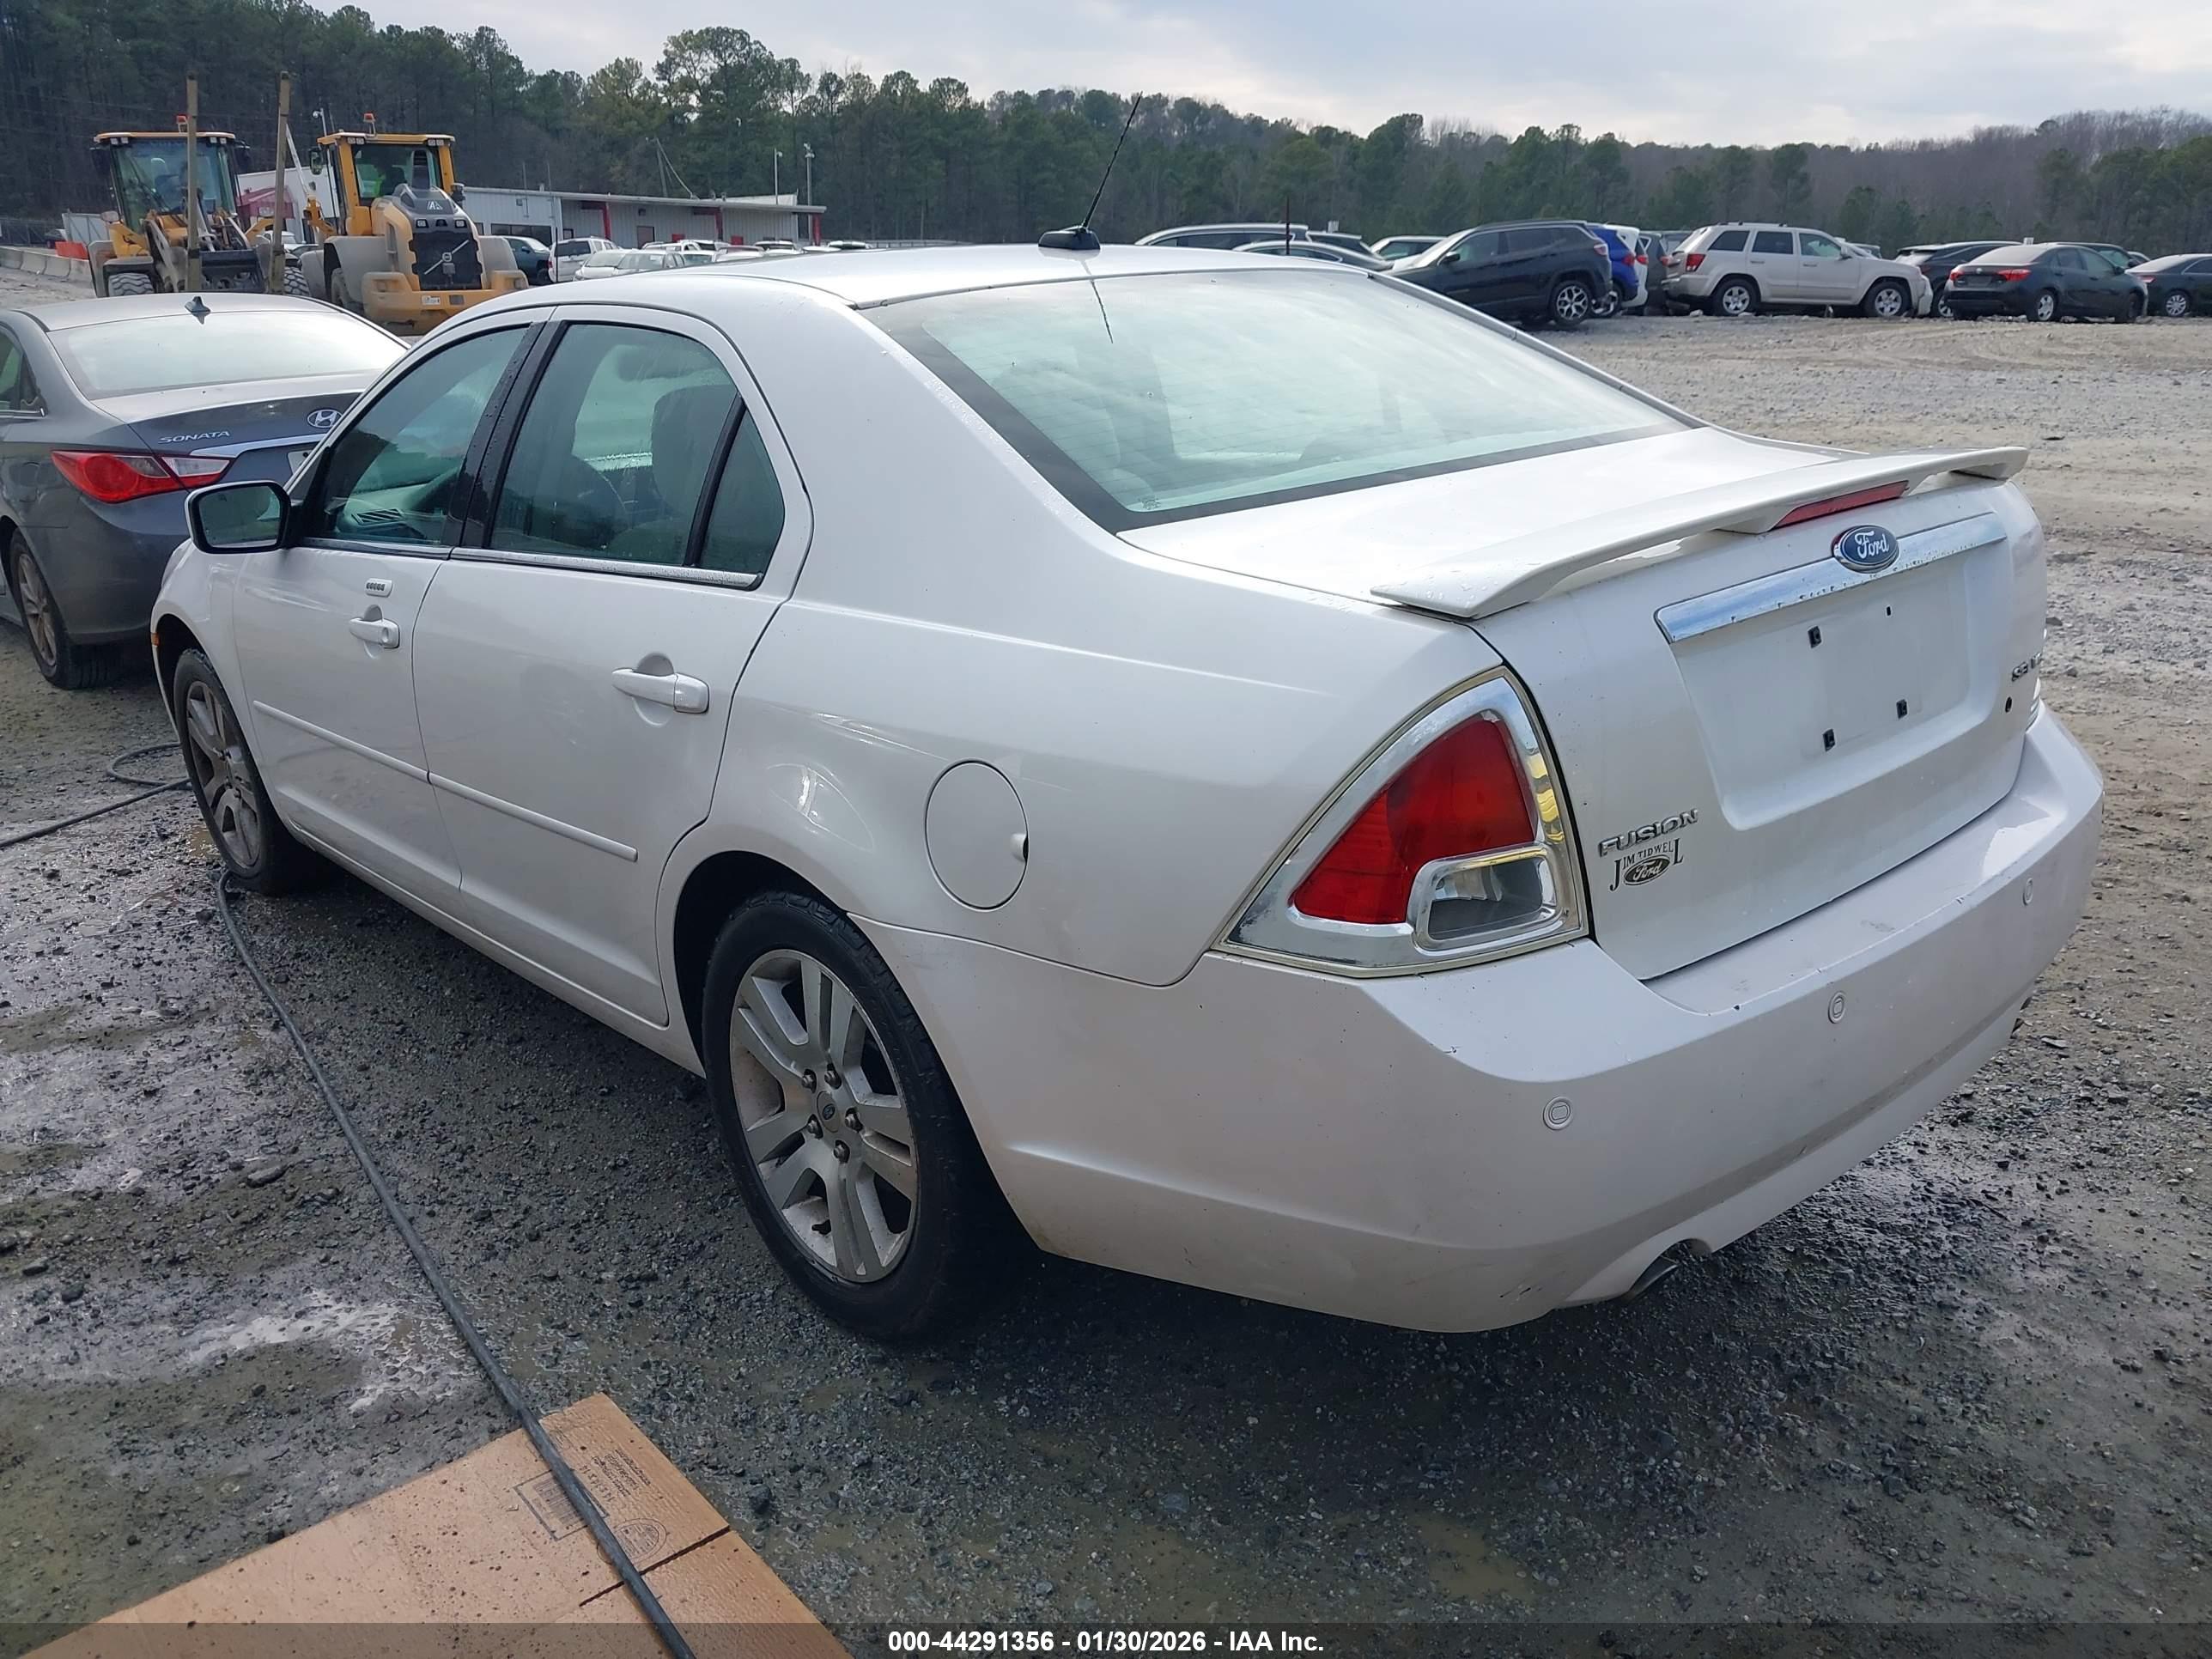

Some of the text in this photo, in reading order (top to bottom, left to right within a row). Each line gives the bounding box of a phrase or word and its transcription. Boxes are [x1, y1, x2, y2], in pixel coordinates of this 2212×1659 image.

[158, 431, 230, 444] SONATA
[1854, 531, 1890, 559] Ford
[1598, 808, 1698, 857] FUSION
[1609, 838, 1684, 891] JIM TIDWELL
[1632, 860, 1663, 881] Ford
